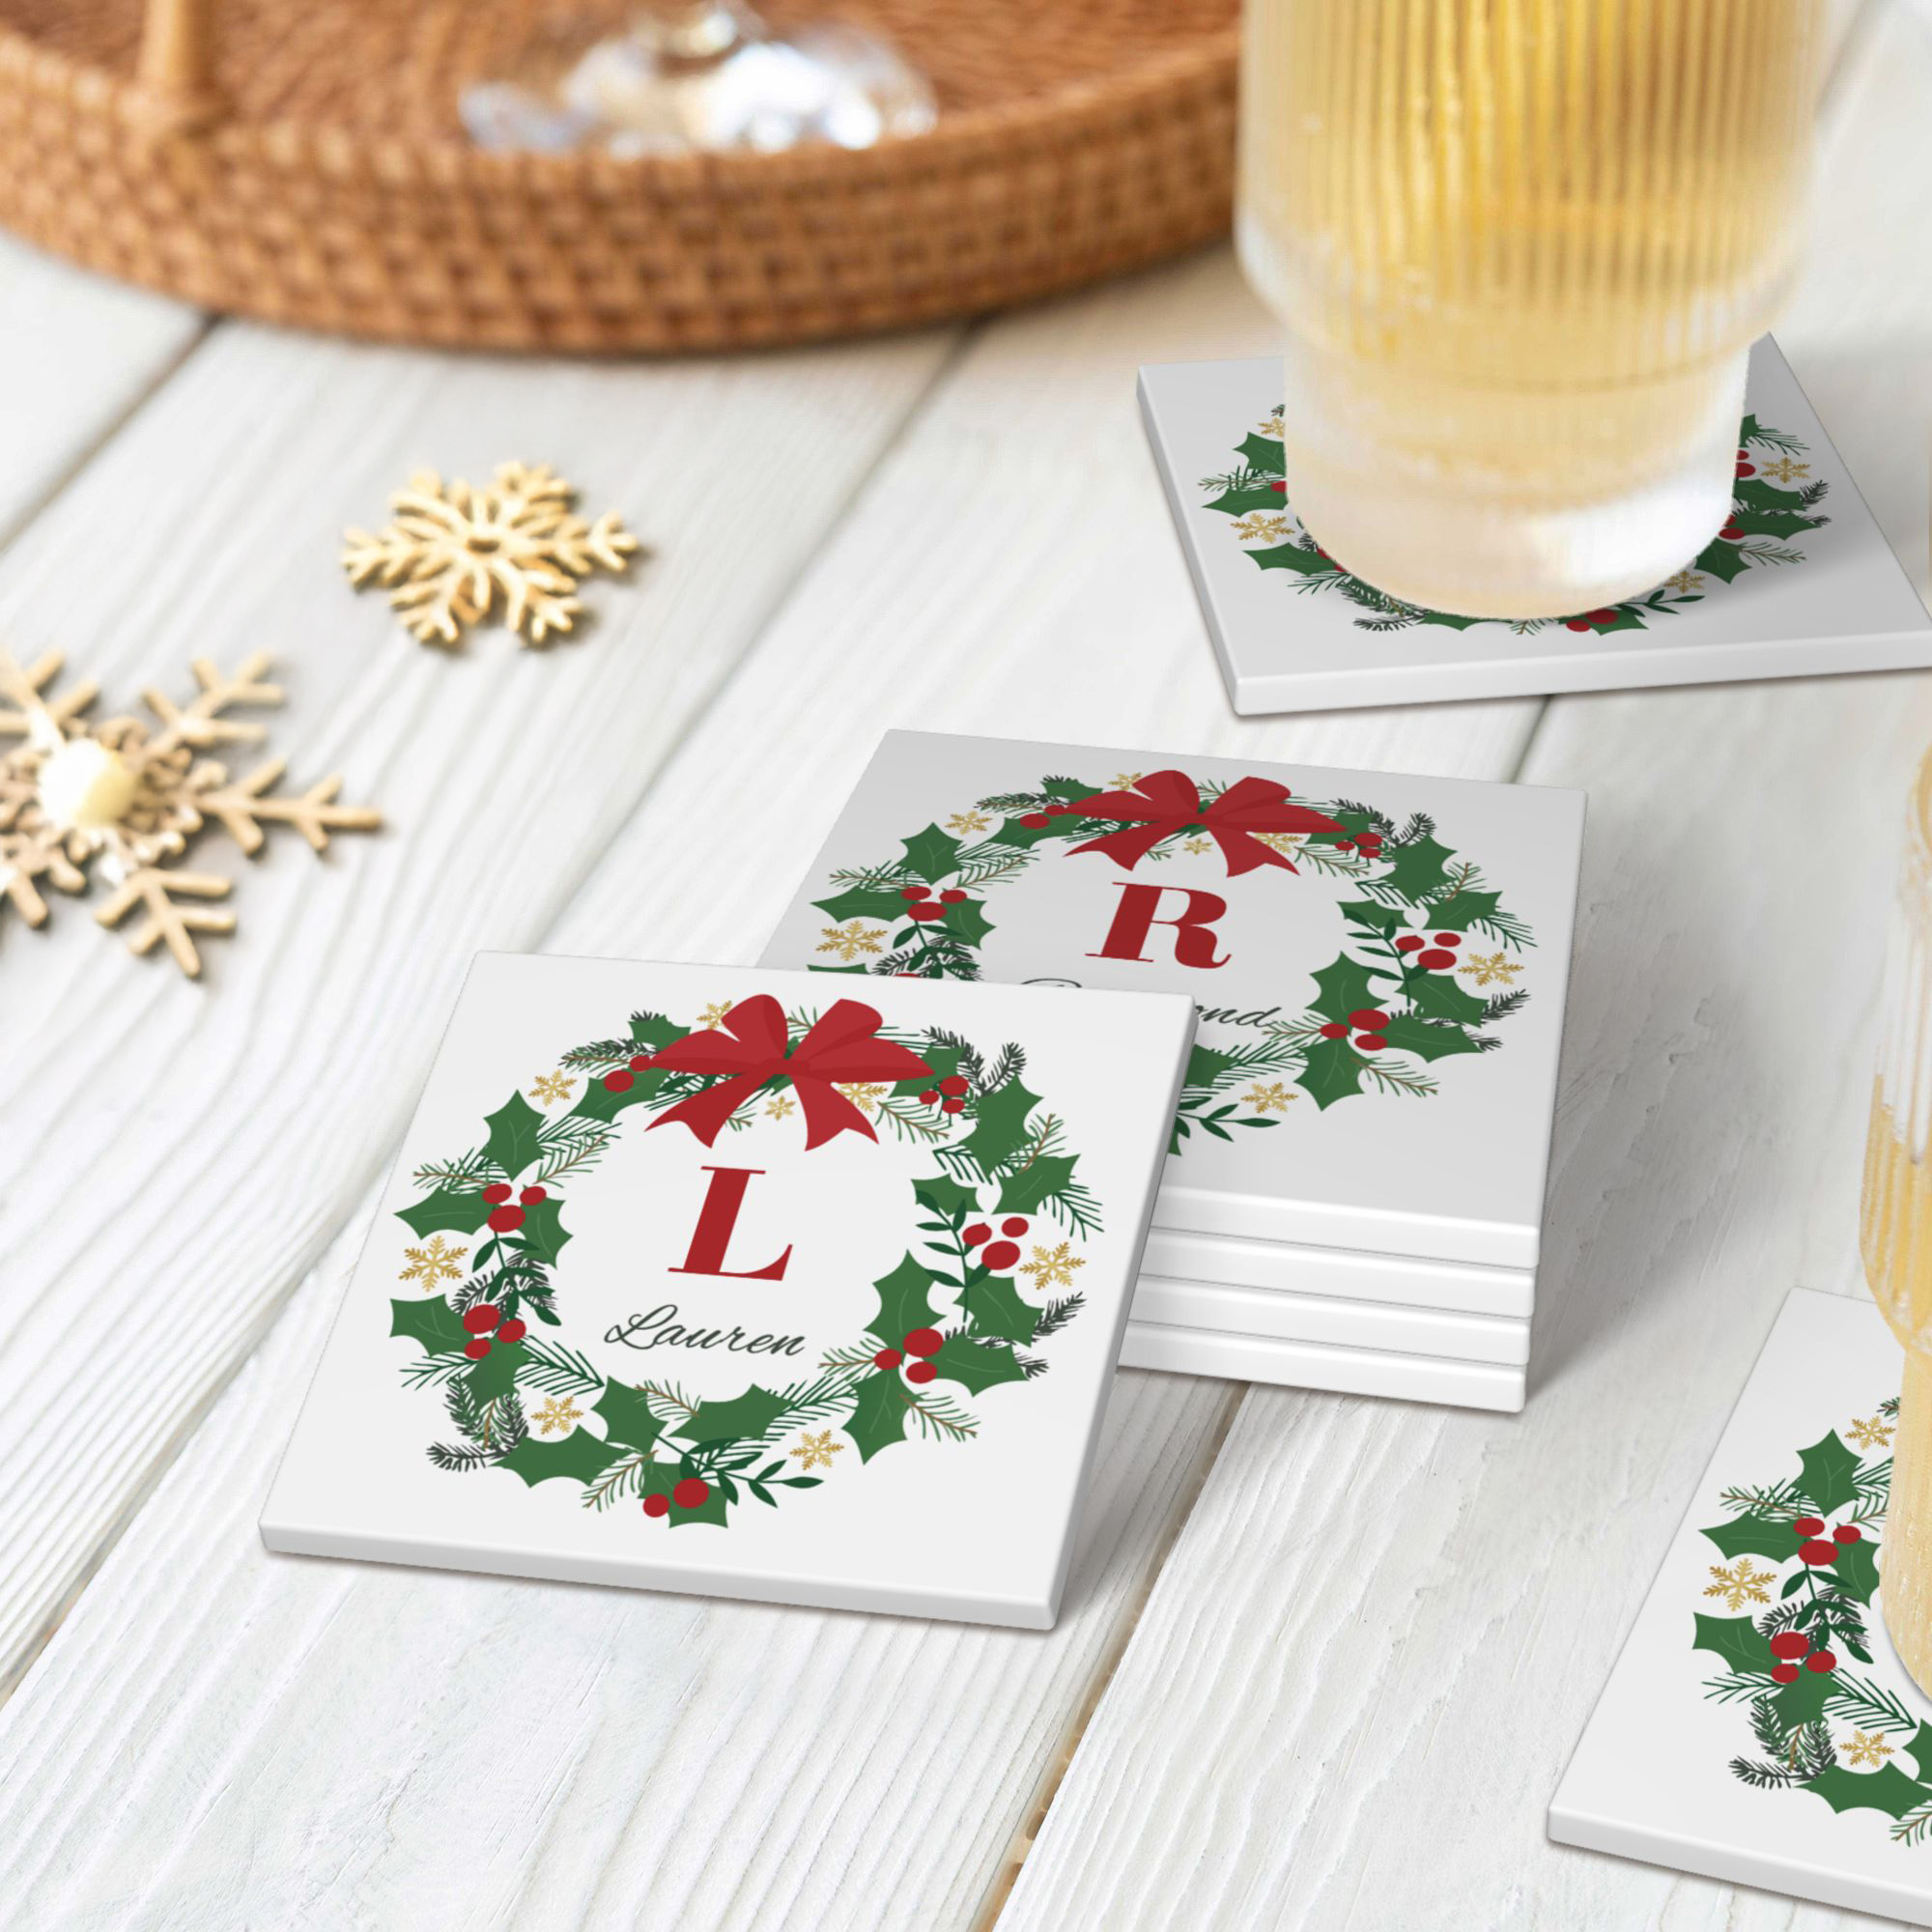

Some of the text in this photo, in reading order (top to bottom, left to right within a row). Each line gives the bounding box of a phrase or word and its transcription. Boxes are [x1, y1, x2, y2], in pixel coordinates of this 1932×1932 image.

[1085, 881, 1232, 969] R
[668, 1166, 793, 1281] L
[604, 1304, 806, 1356] Lauren
